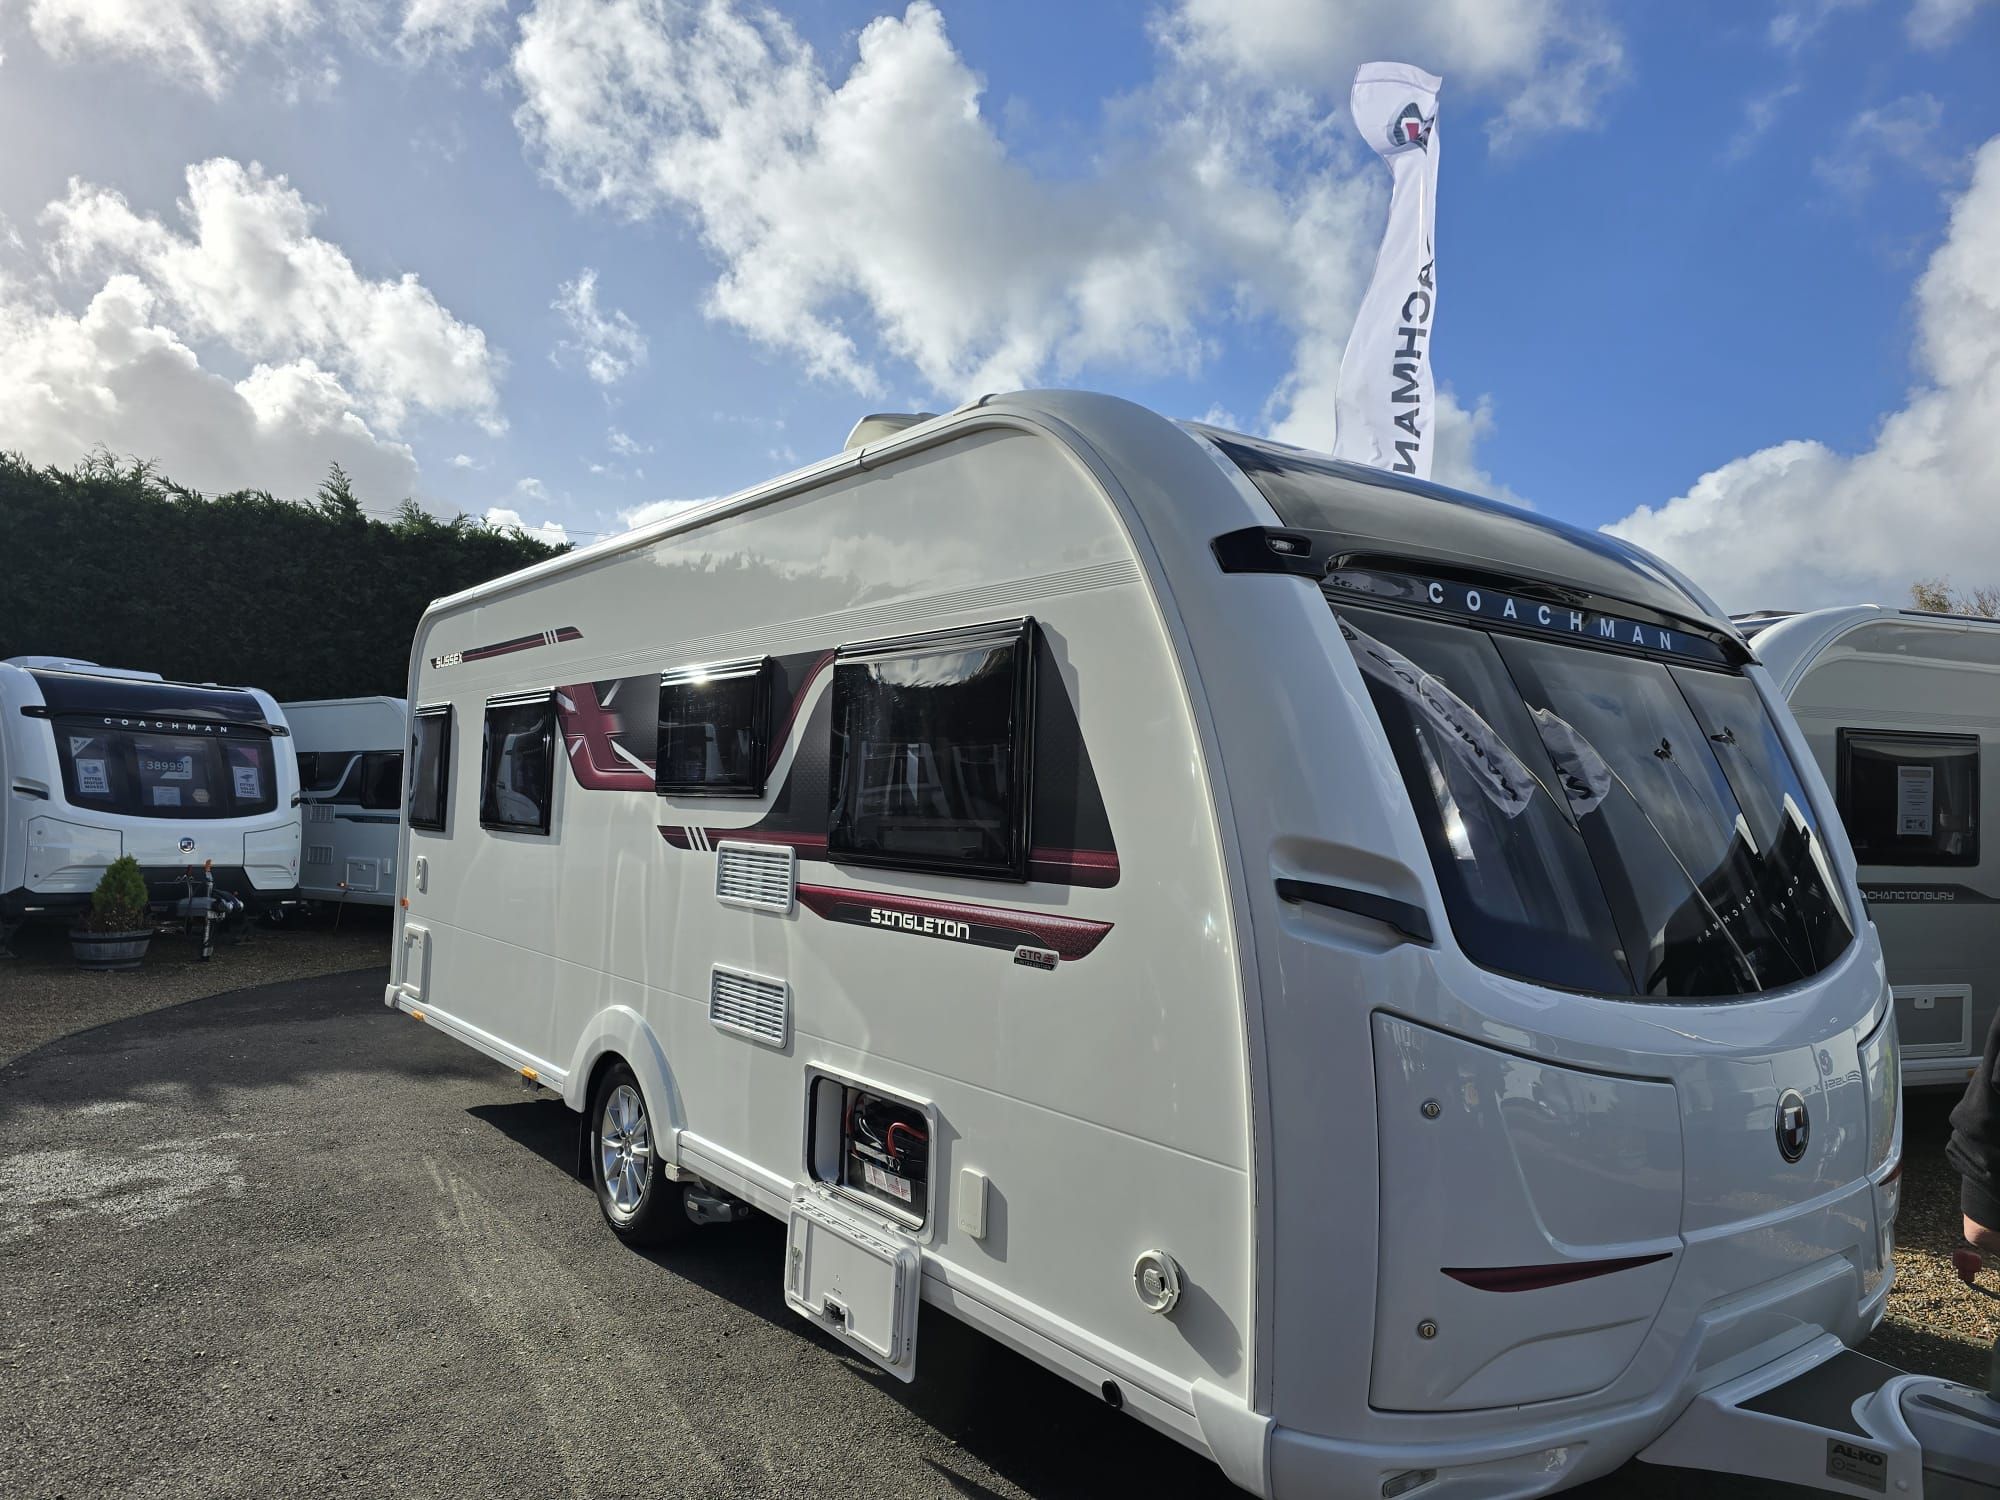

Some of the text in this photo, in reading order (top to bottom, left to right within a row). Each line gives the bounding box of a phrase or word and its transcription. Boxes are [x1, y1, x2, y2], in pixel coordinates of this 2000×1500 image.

[1428, 582, 1672, 650] COACHMAN
[435, 651, 463, 670] SUSSEX
[104, 717, 227, 733] COACHMAN
[1867, 891, 1954, 901] CHANCTONBURY
[870, 908, 970, 940] SINGLETON
[1018, 949, 1042, 961] GTR
